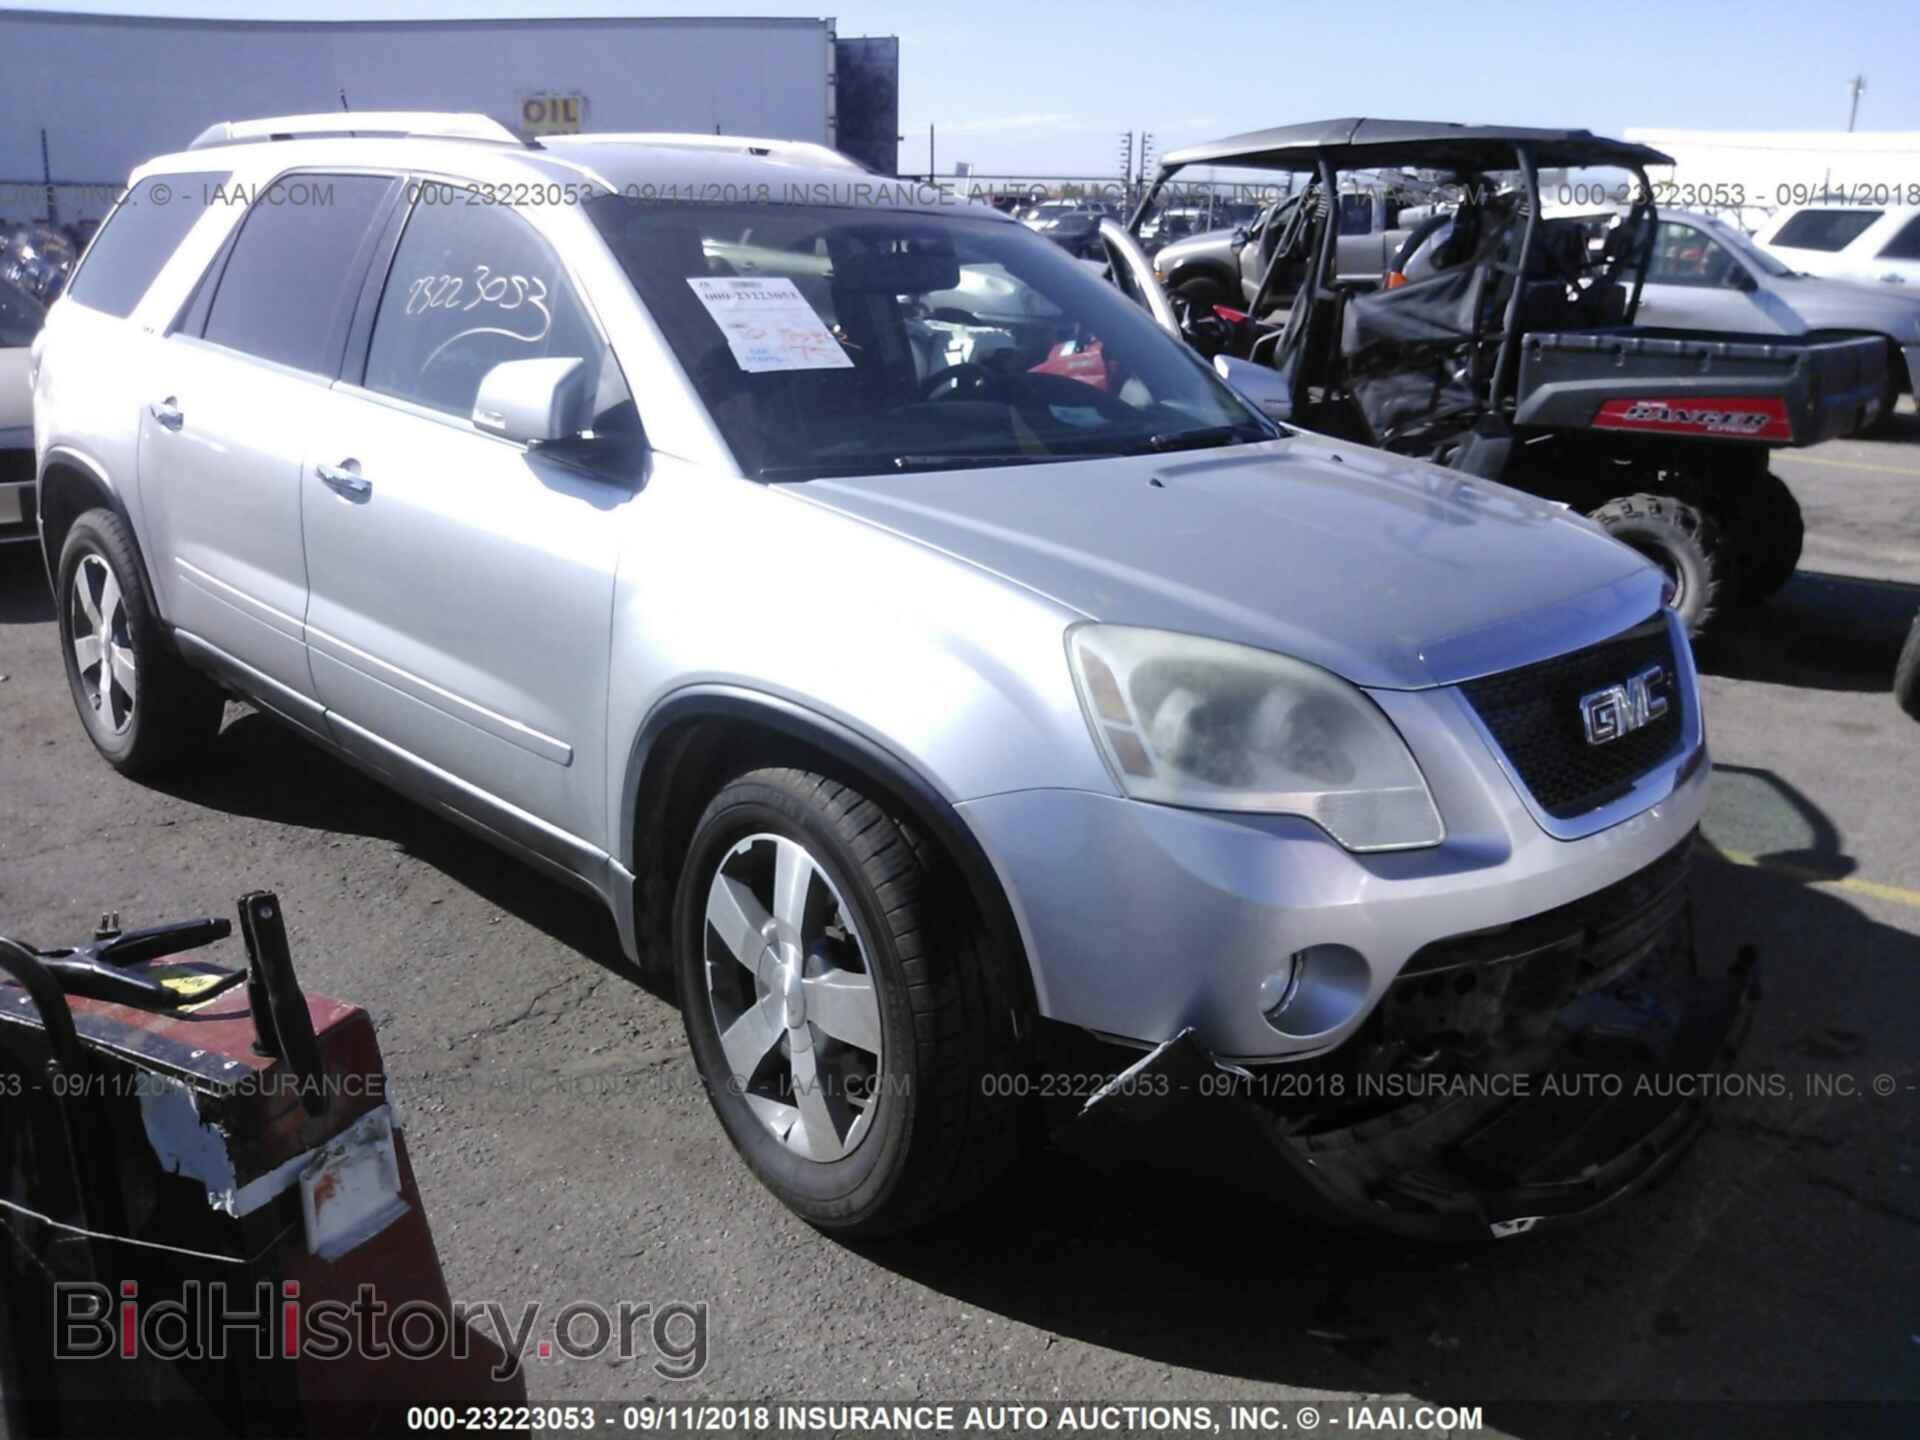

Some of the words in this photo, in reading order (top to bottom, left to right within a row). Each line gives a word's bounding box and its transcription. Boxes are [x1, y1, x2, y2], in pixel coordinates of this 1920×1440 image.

[523, 98, 577, 123] OIL
[1622, 404, 1770, 427] RANGER
[1580, 665, 1667, 745] GMC
